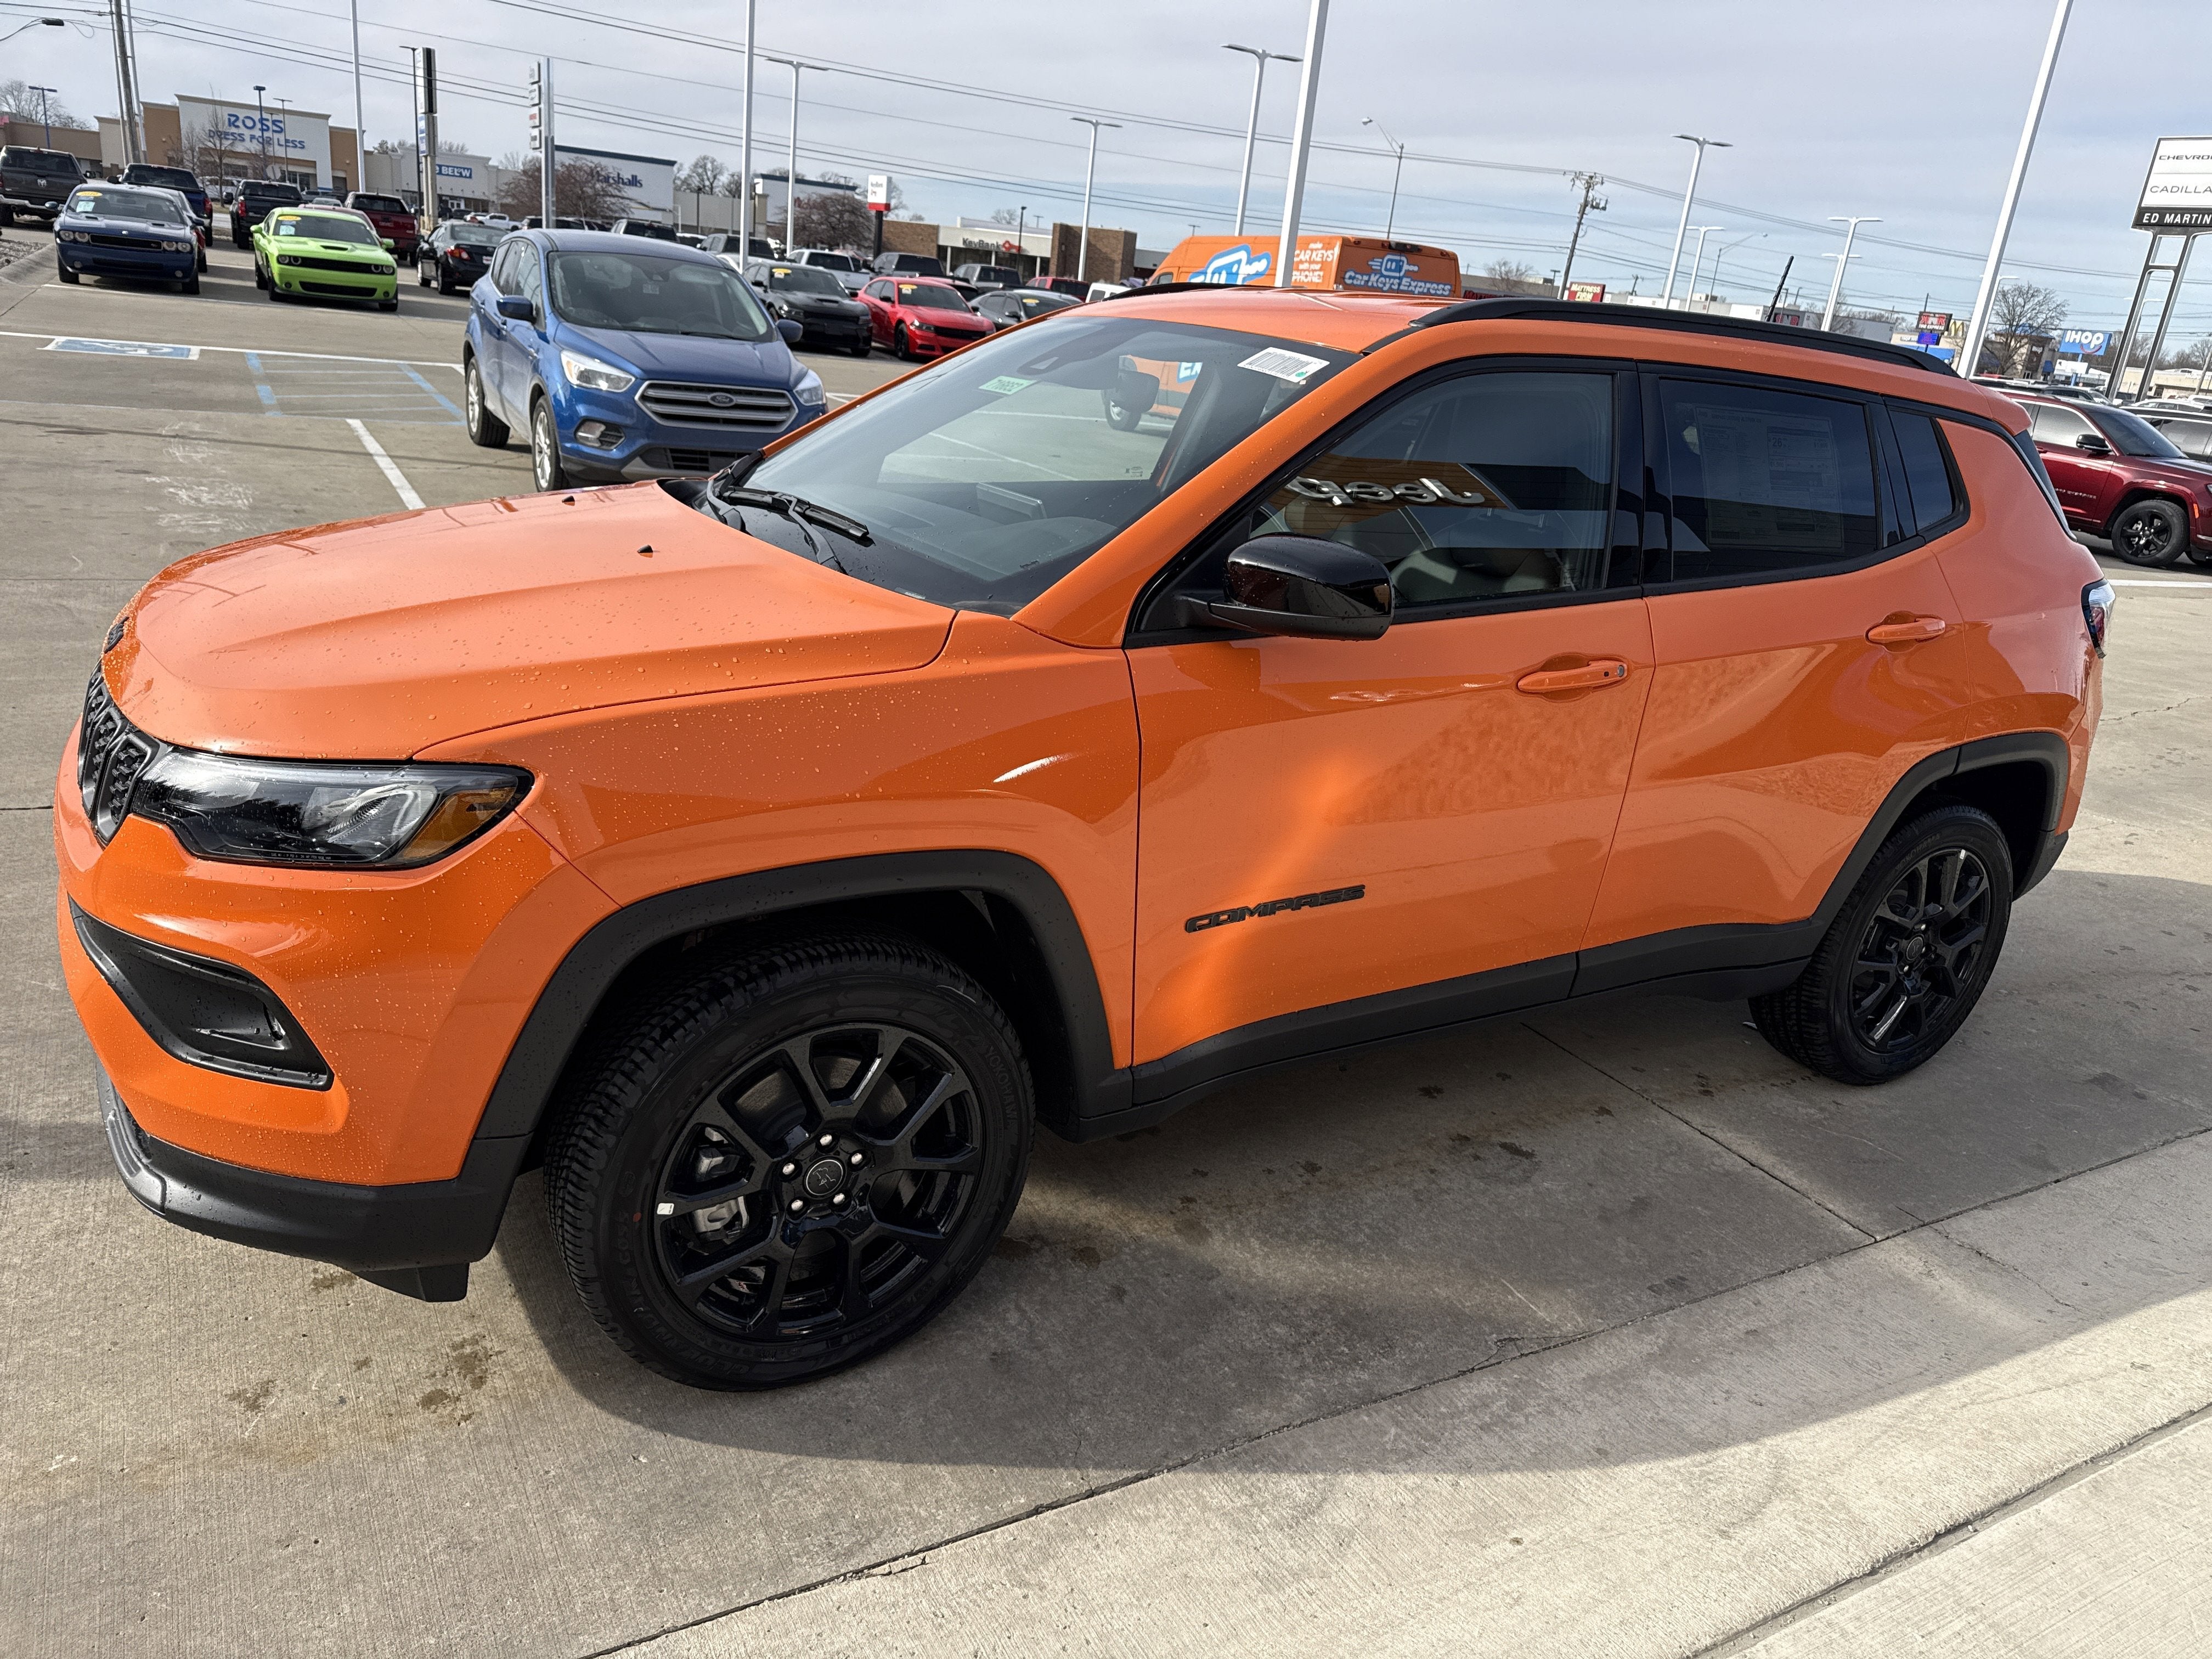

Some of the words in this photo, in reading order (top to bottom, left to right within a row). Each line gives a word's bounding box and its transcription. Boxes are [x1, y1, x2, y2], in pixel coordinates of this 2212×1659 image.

[227, 113, 284, 133] ROSS
[208, 129, 245, 143] DRESS
[249, 134, 273, 145] FOR
[276, 138, 306, 149] LESS
[2142, 213, 2159, 223] ED
[2164, 213, 2212, 224] MARTIN
[962, 237, 1001, 251] KeyBank
[1294, 250, 1311, 262] CAR
[1311, 250, 1334, 262] KEYS
[2065, 330, 2104, 349] IHOP
[1184, 884, 1366, 933] COMPASS
[985, 1046, 1018, 1129] YOKOHAMA
